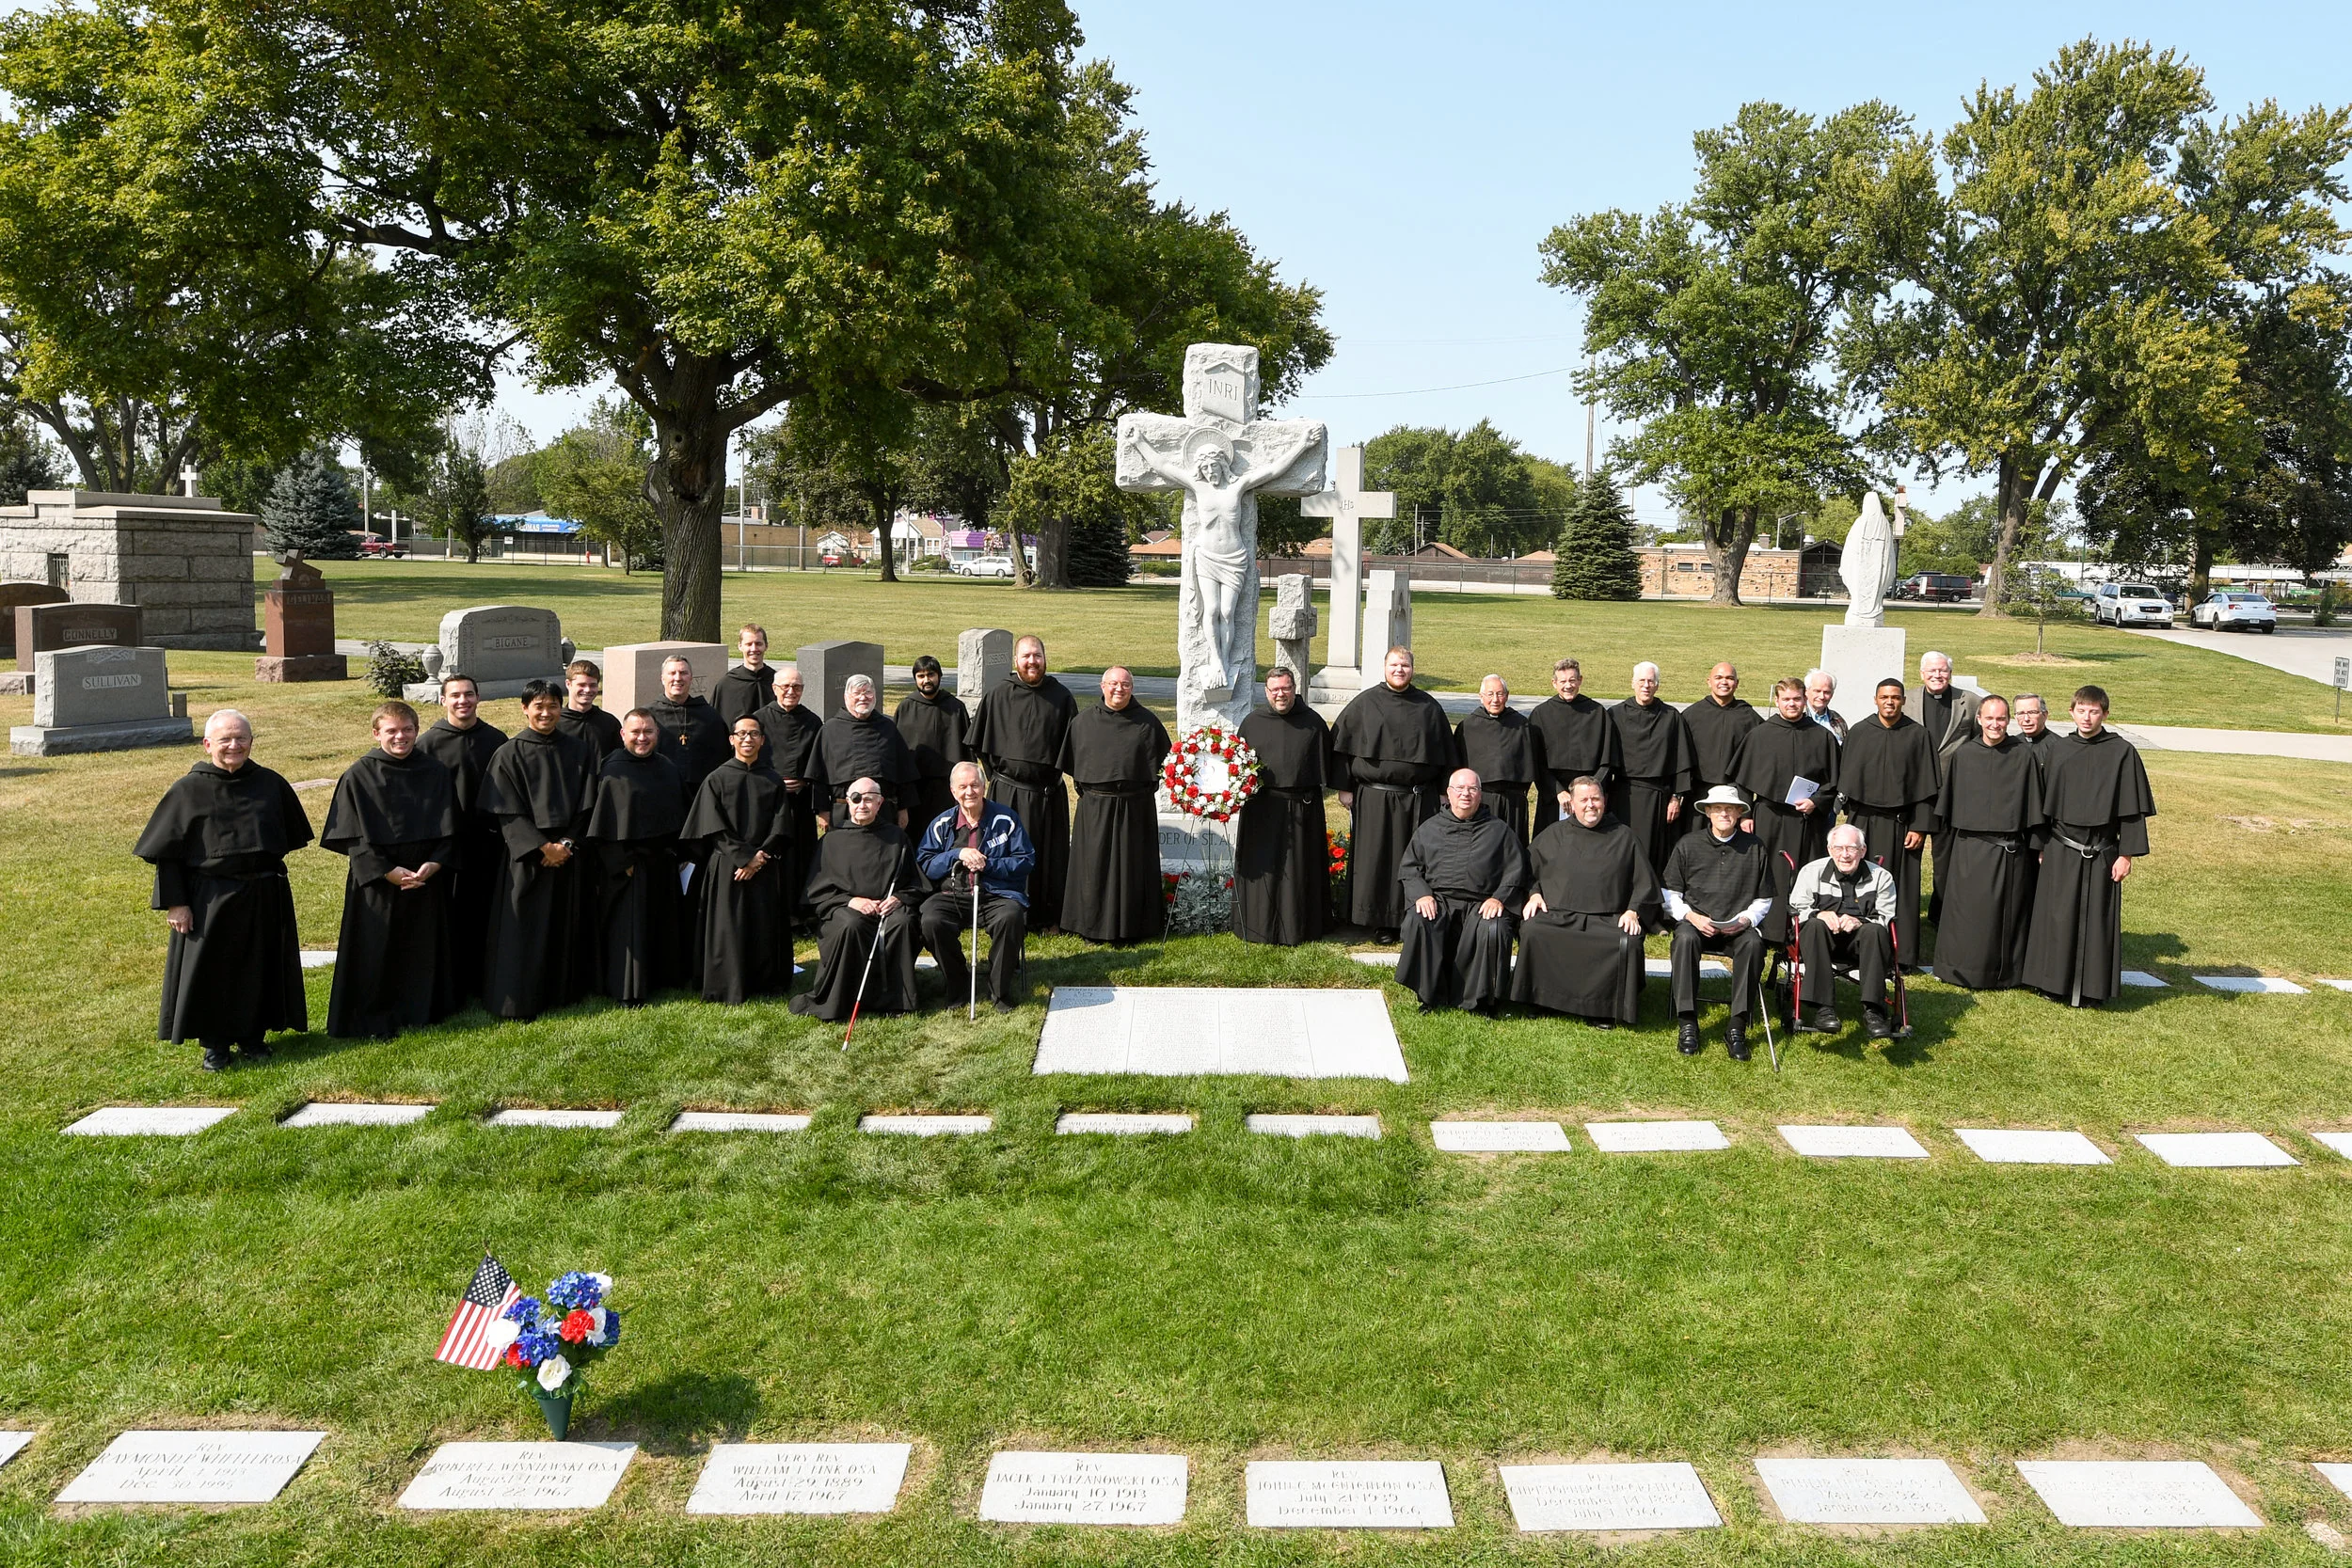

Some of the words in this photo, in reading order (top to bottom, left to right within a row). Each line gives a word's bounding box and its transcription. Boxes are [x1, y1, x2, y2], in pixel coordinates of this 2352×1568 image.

[1209, 378, 1238, 402] INRI
[64, 629, 116, 641] CONNELLY
[495, 638, 528, 648] BIGANE
[85, 675, 138, 688] SULLIVAN
[1184, 832, 1200, 846] OF
[776, 1453, 808, 1463] VERY
[133, 1466, 184, 1480] April
[733, 1465, 790, 1475] WILLIAM
[459, 1473, 515, 1486] August
[734, 1477, 787, 1490] August
[824, 1478, 864, 1487] 1889
[993, 1474, 1033, 1484] JACEK
[1258, 1481, 1292, 1490] JOHN
[438, 1486, 494, 1498] August
[534, 1487, 575, 1497] 1967
[739, 1490, 778, 1501] April
[809, 1491, 848, 1501] 1967
[1022, 1487, 1078, 1499] January
[1117, 1488, 1147, 1498] 1913
[1297, 1493, 1327, 1504] July
[1536, 1496, 1613, 1507] December
[1018, 1499, 1073, 1513] January
[1110, 1501, 1147, 1513] 1967
[1279, 1506, 1356, 1515] December
[1573, 1508, 1602, 1520] July
